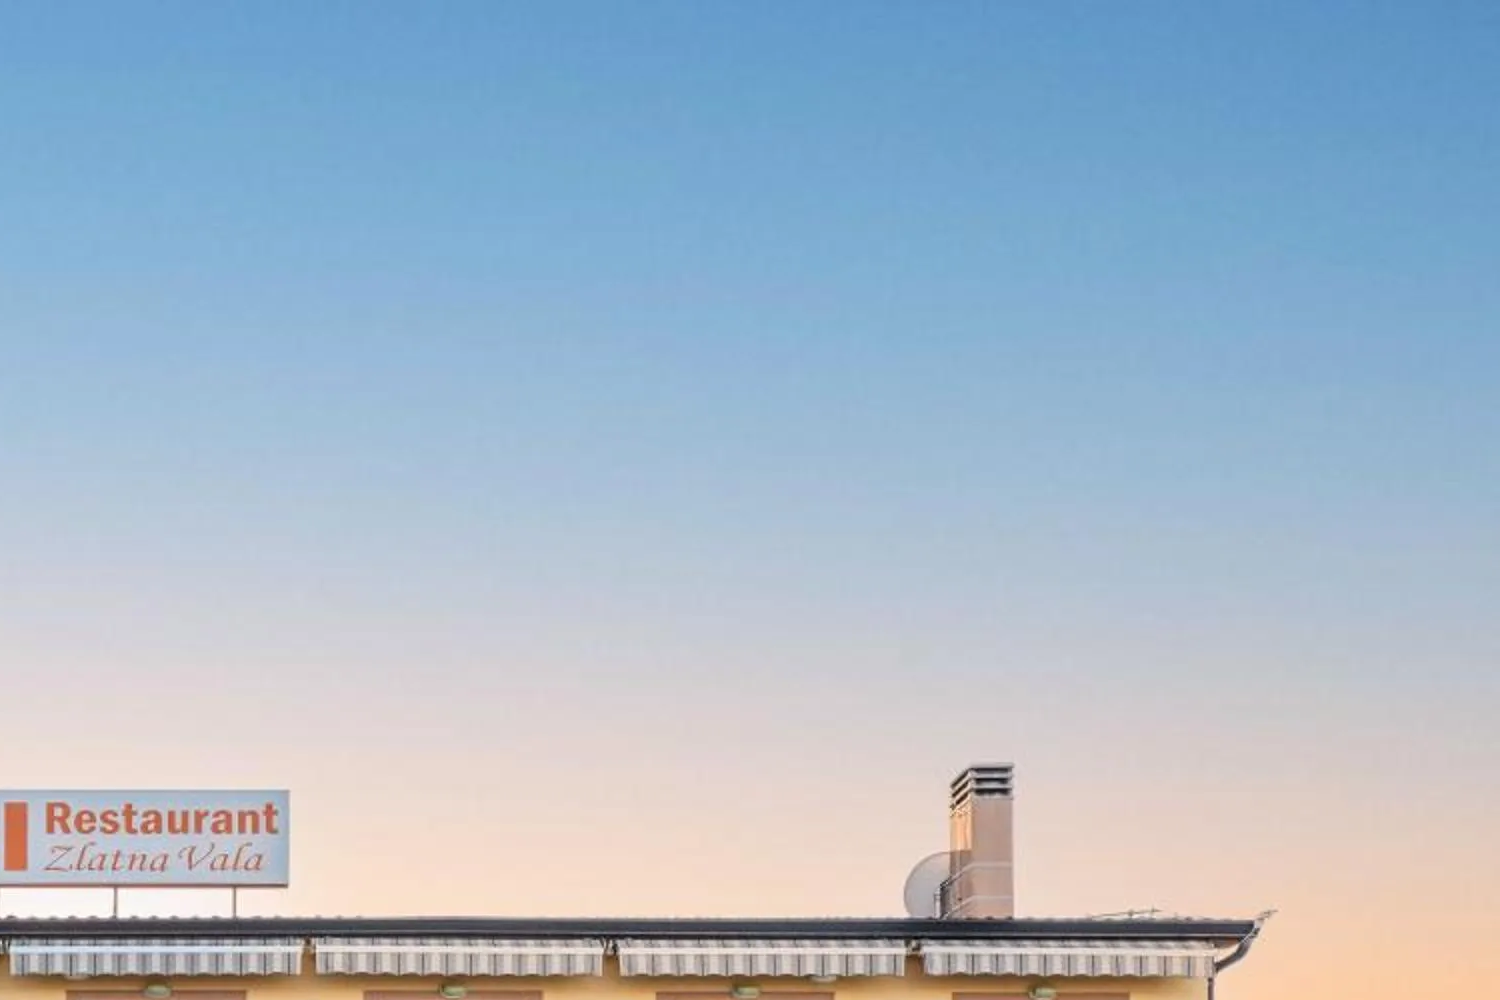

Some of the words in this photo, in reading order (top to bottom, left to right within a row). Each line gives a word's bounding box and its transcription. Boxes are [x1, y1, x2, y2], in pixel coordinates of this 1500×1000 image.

[45, 801, 280, 835] Restaurant
[43, 841, 170, 873] Zlatna
[176, 842, 264, 872] Vala
